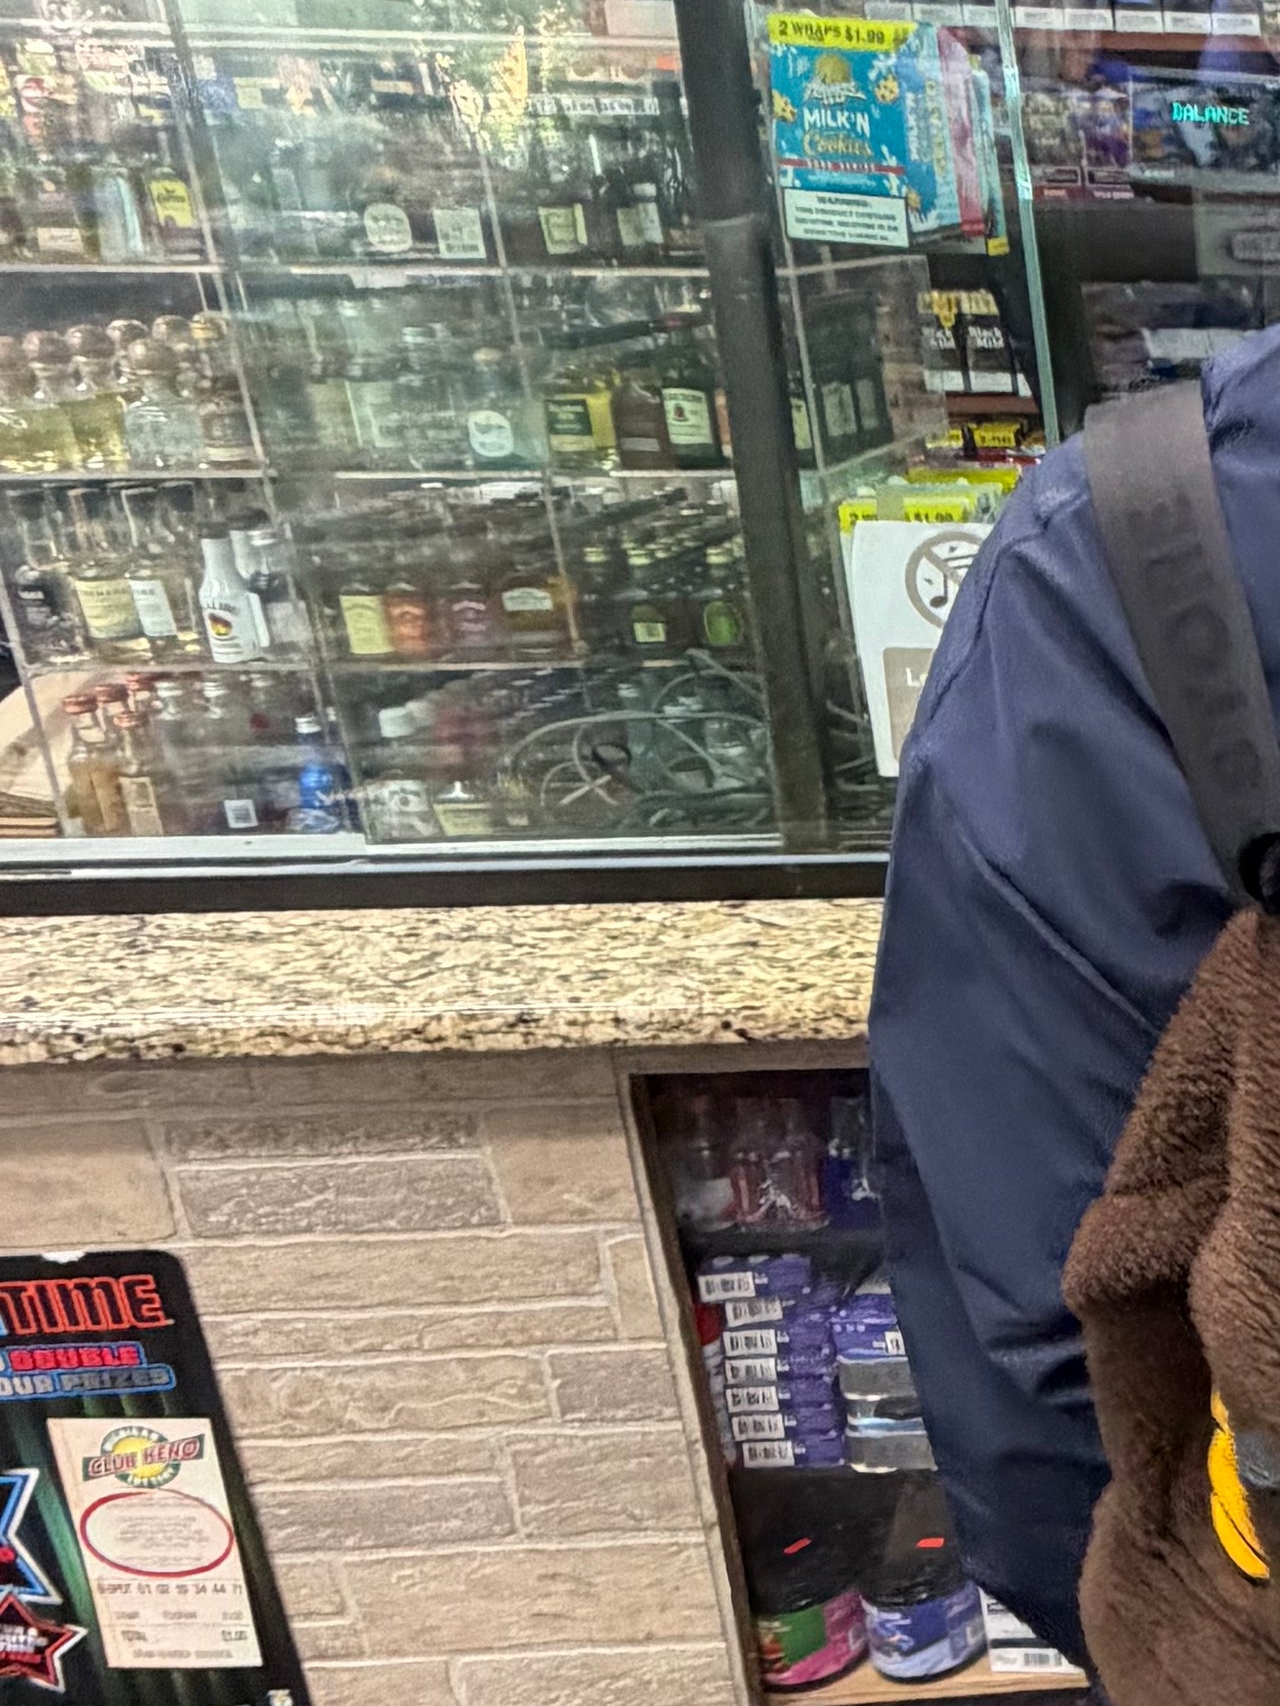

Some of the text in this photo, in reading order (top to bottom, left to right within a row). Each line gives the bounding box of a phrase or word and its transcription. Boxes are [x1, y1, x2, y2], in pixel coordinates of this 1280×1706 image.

[0, 1274, 171, 1336] TIME
[8, 1345, 142, 1374] DOUBLE
[59, 1367, 171, 1393] PRIZES
[88, 1437, 200, 1477] CLUB KENO
